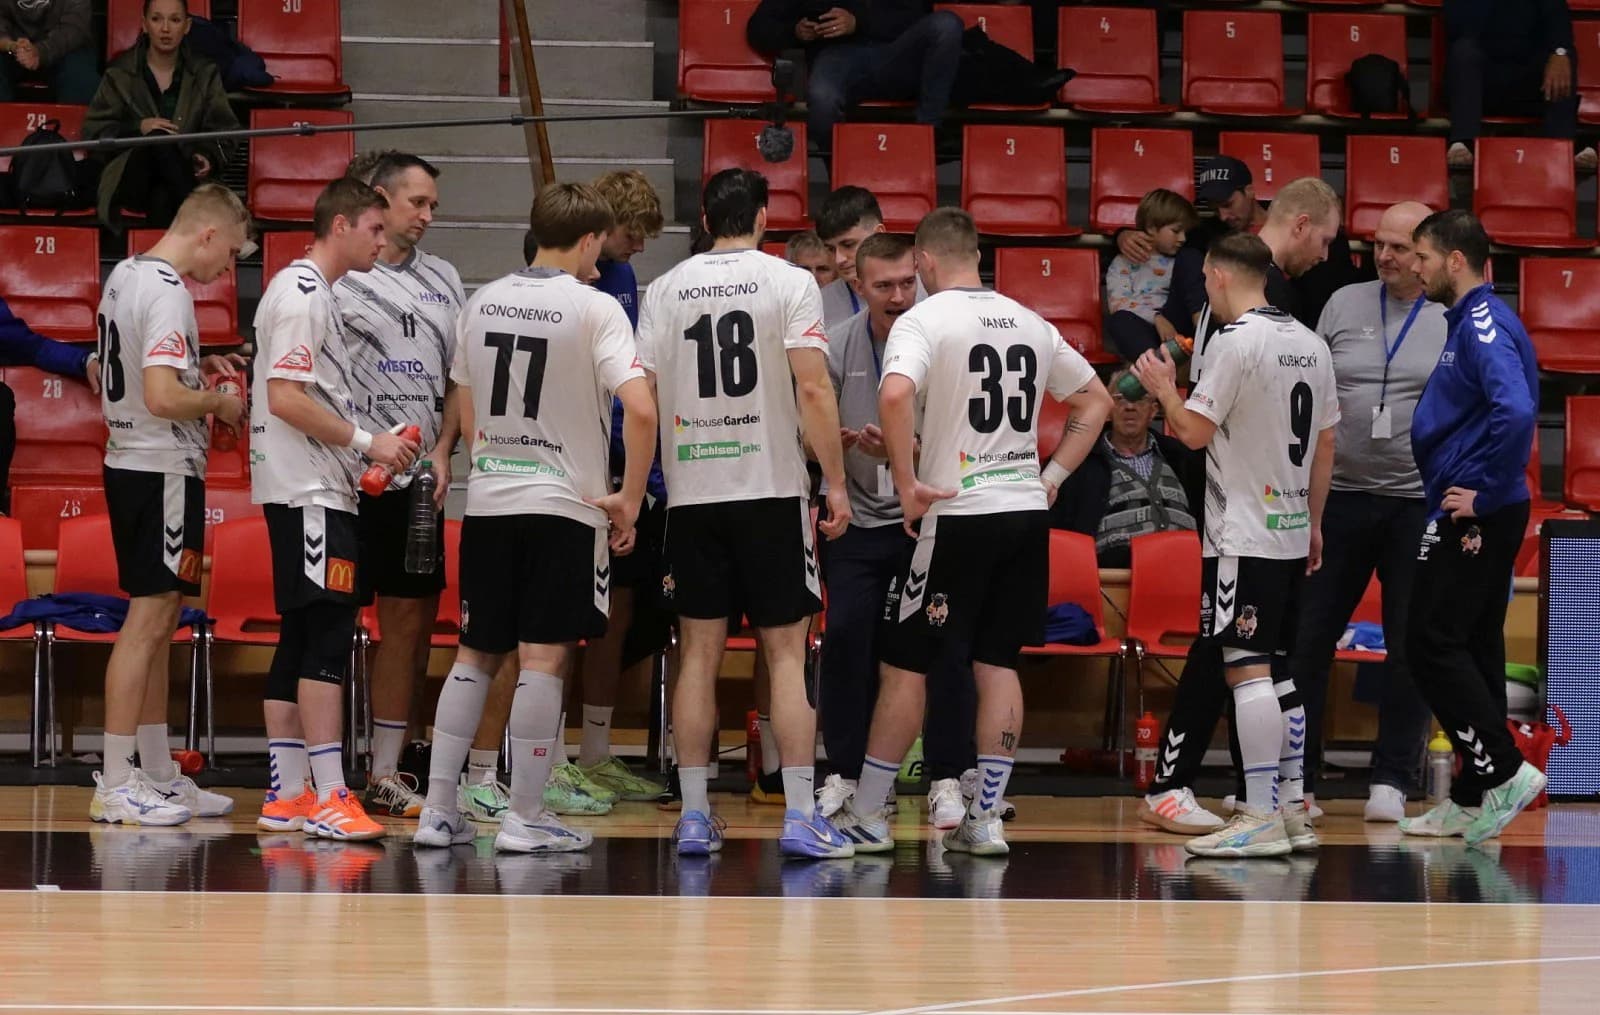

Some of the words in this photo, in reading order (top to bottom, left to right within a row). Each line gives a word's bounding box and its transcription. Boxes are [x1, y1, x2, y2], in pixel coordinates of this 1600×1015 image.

[282, 0, 302, 13] 30
[723, 9, 731, 25] 1
[1100, 17, 1111, 34] 4
[1225, 21, 1236, 38] 5
[1350, 25, 1360, 42] 6
[878, 134, 888, 151] 2
[1005, 138, 1015, 156] 3
[1133, 139, 1145, 157] 4
[1262, 144, 1272, 161] 5
[1390, 147, 1400, 164] 6
[1515, 149, 1525, 164] 7
[35, 237, 56, 254] 28
[1041, 259, 1051, 277] 3
[1561, 270, 1573, 288] 7
[678, 282, 759, 302] MONTECINO
[479, 303, 563, 324] KONONENKO
[977, 315, 1018, 329] VANEK
[400, 312, 416, 338] 11
[683, 309, 758, 399] 18
[484, 331, 549, 421] 77
[42, 380, 63, 399] 28
[968, 343, 1038, 434] 33
[1288, 381, 1314, 467] 9
[978, 450, 1036, 464] HouseGarden
